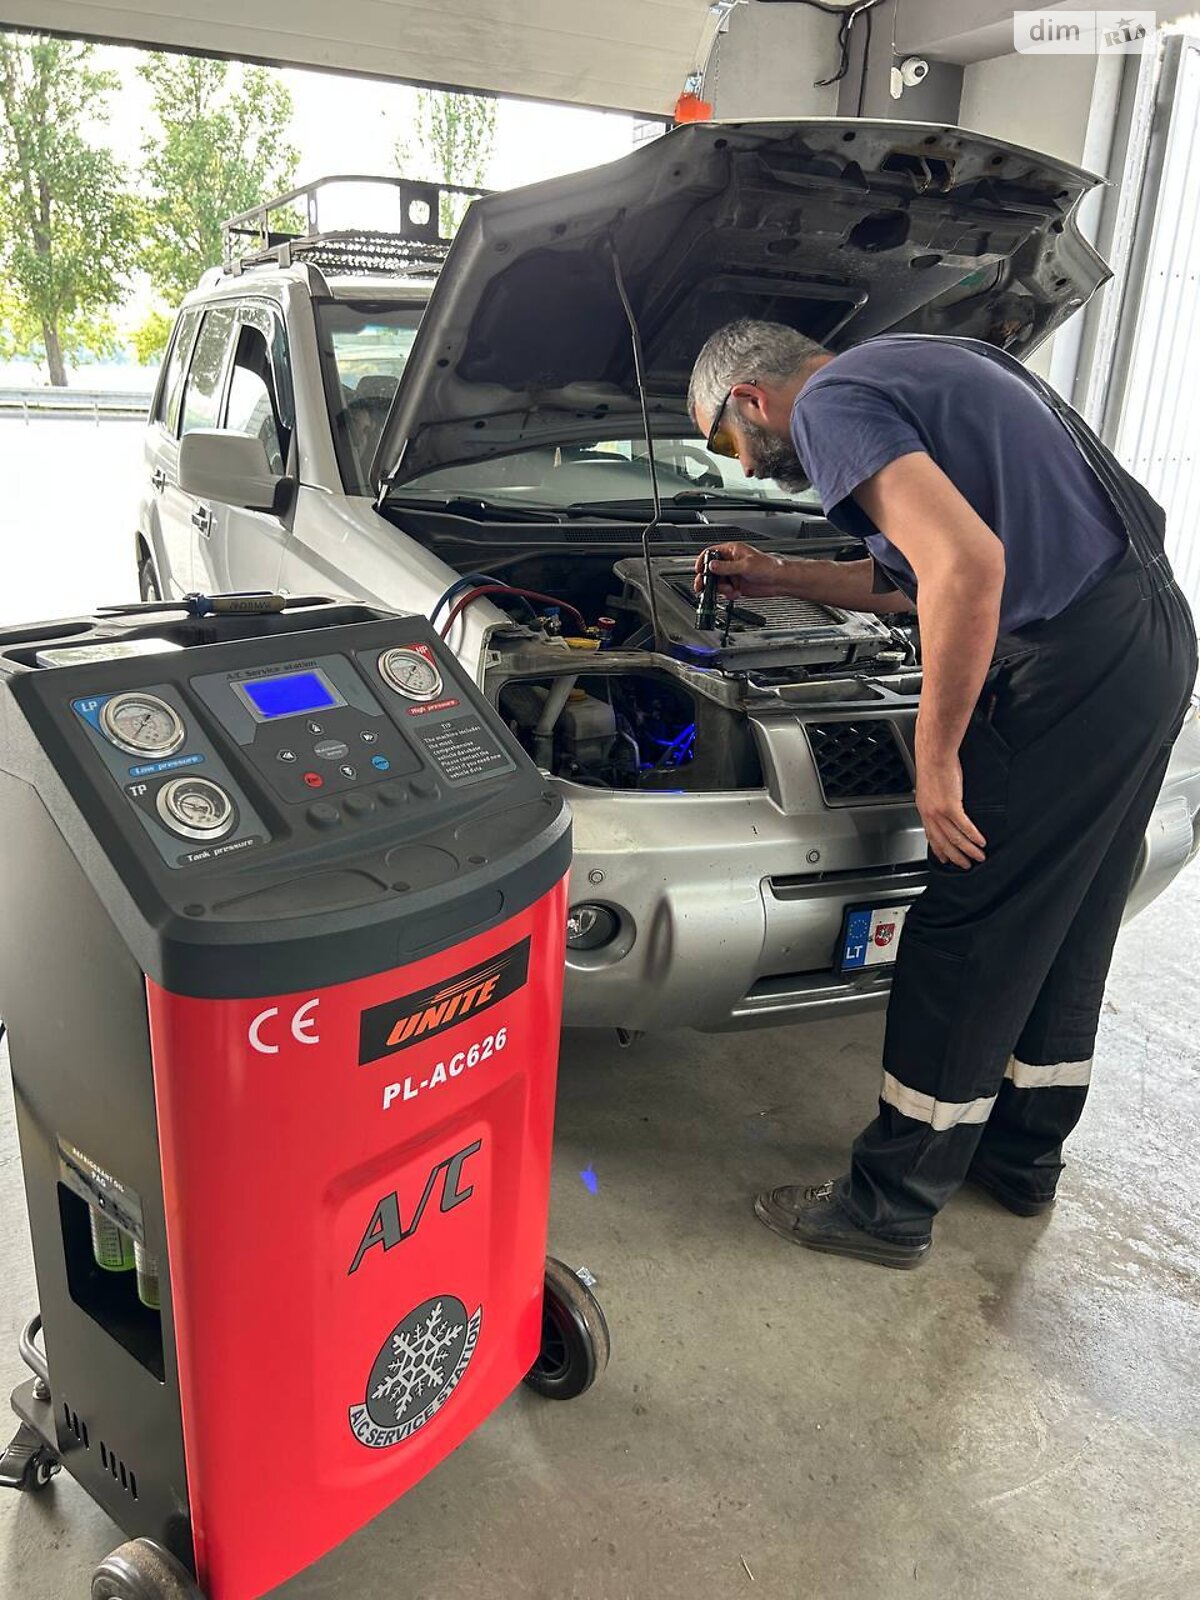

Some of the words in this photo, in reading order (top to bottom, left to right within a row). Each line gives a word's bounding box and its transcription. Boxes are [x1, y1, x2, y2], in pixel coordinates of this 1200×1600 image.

[415, 645, 428, 654] HP
[81, 701, 97, 712] LP
[427, 700, 455, 711] pressure
[135, 765, 153, 775] Low
[158, 755, 200, 772] pressure
[129, 784, 147, 797] TP
[187, 850, 210, 863] Tank
[213, 839, 254, 857] pressure
[845, 945, 863, 960] LT
[385, 974, 500, 1047] UNITE
[383, 1027, 507, 1110] PL-AC626
[348, 1138, 482, 1276] A/C
[351, 1409, 370, 1438] A/C
[365, 1406, 435, 1447] SERVICE
[435, 1315, 480, 1403] STATION
